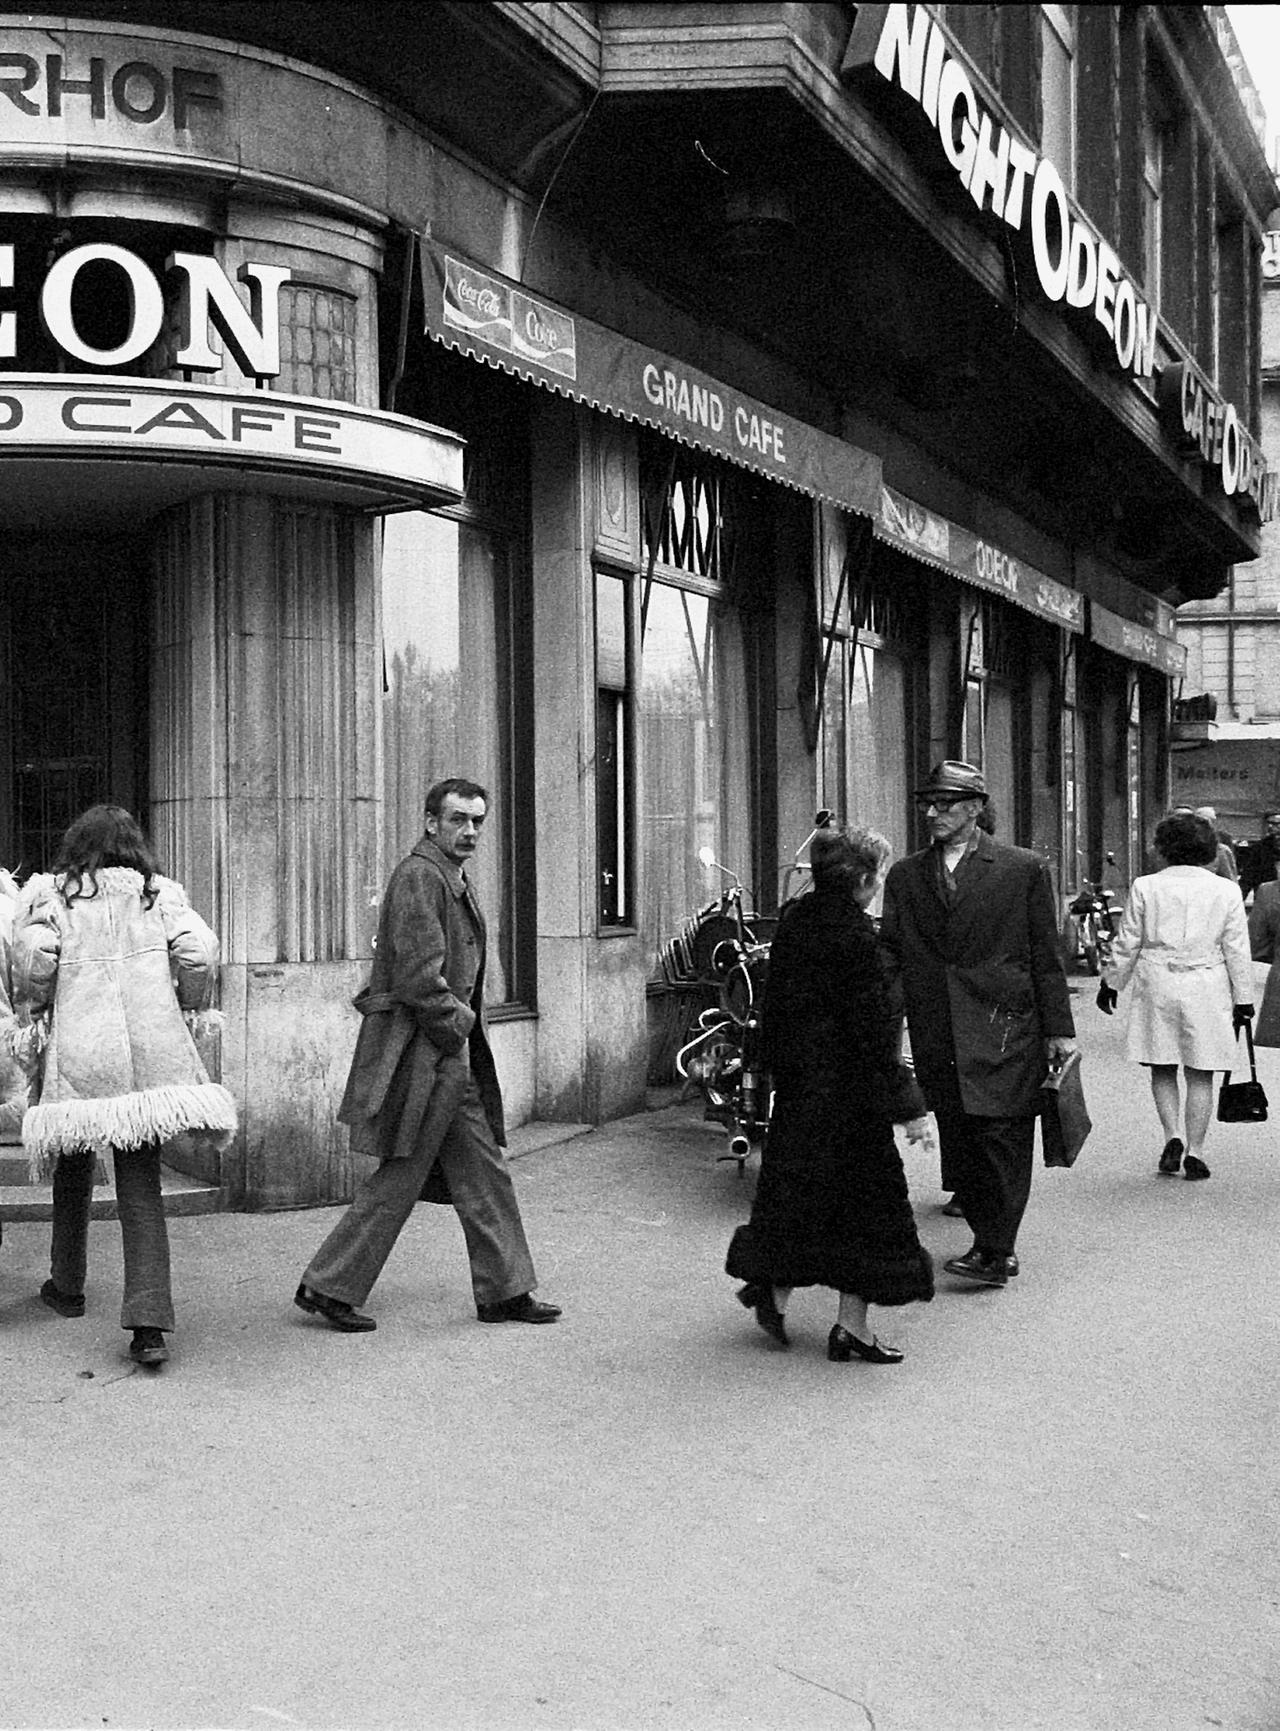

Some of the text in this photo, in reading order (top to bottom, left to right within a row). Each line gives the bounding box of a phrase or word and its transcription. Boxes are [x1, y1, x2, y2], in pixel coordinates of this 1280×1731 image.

[873, 4, 1158, 378] NIGHT ODEON
[457, 278, 501, 317] Coca-Cola
[60, 396, 343, 455] CAFE
[642, 363, 787, 464] GRAND CAFE
